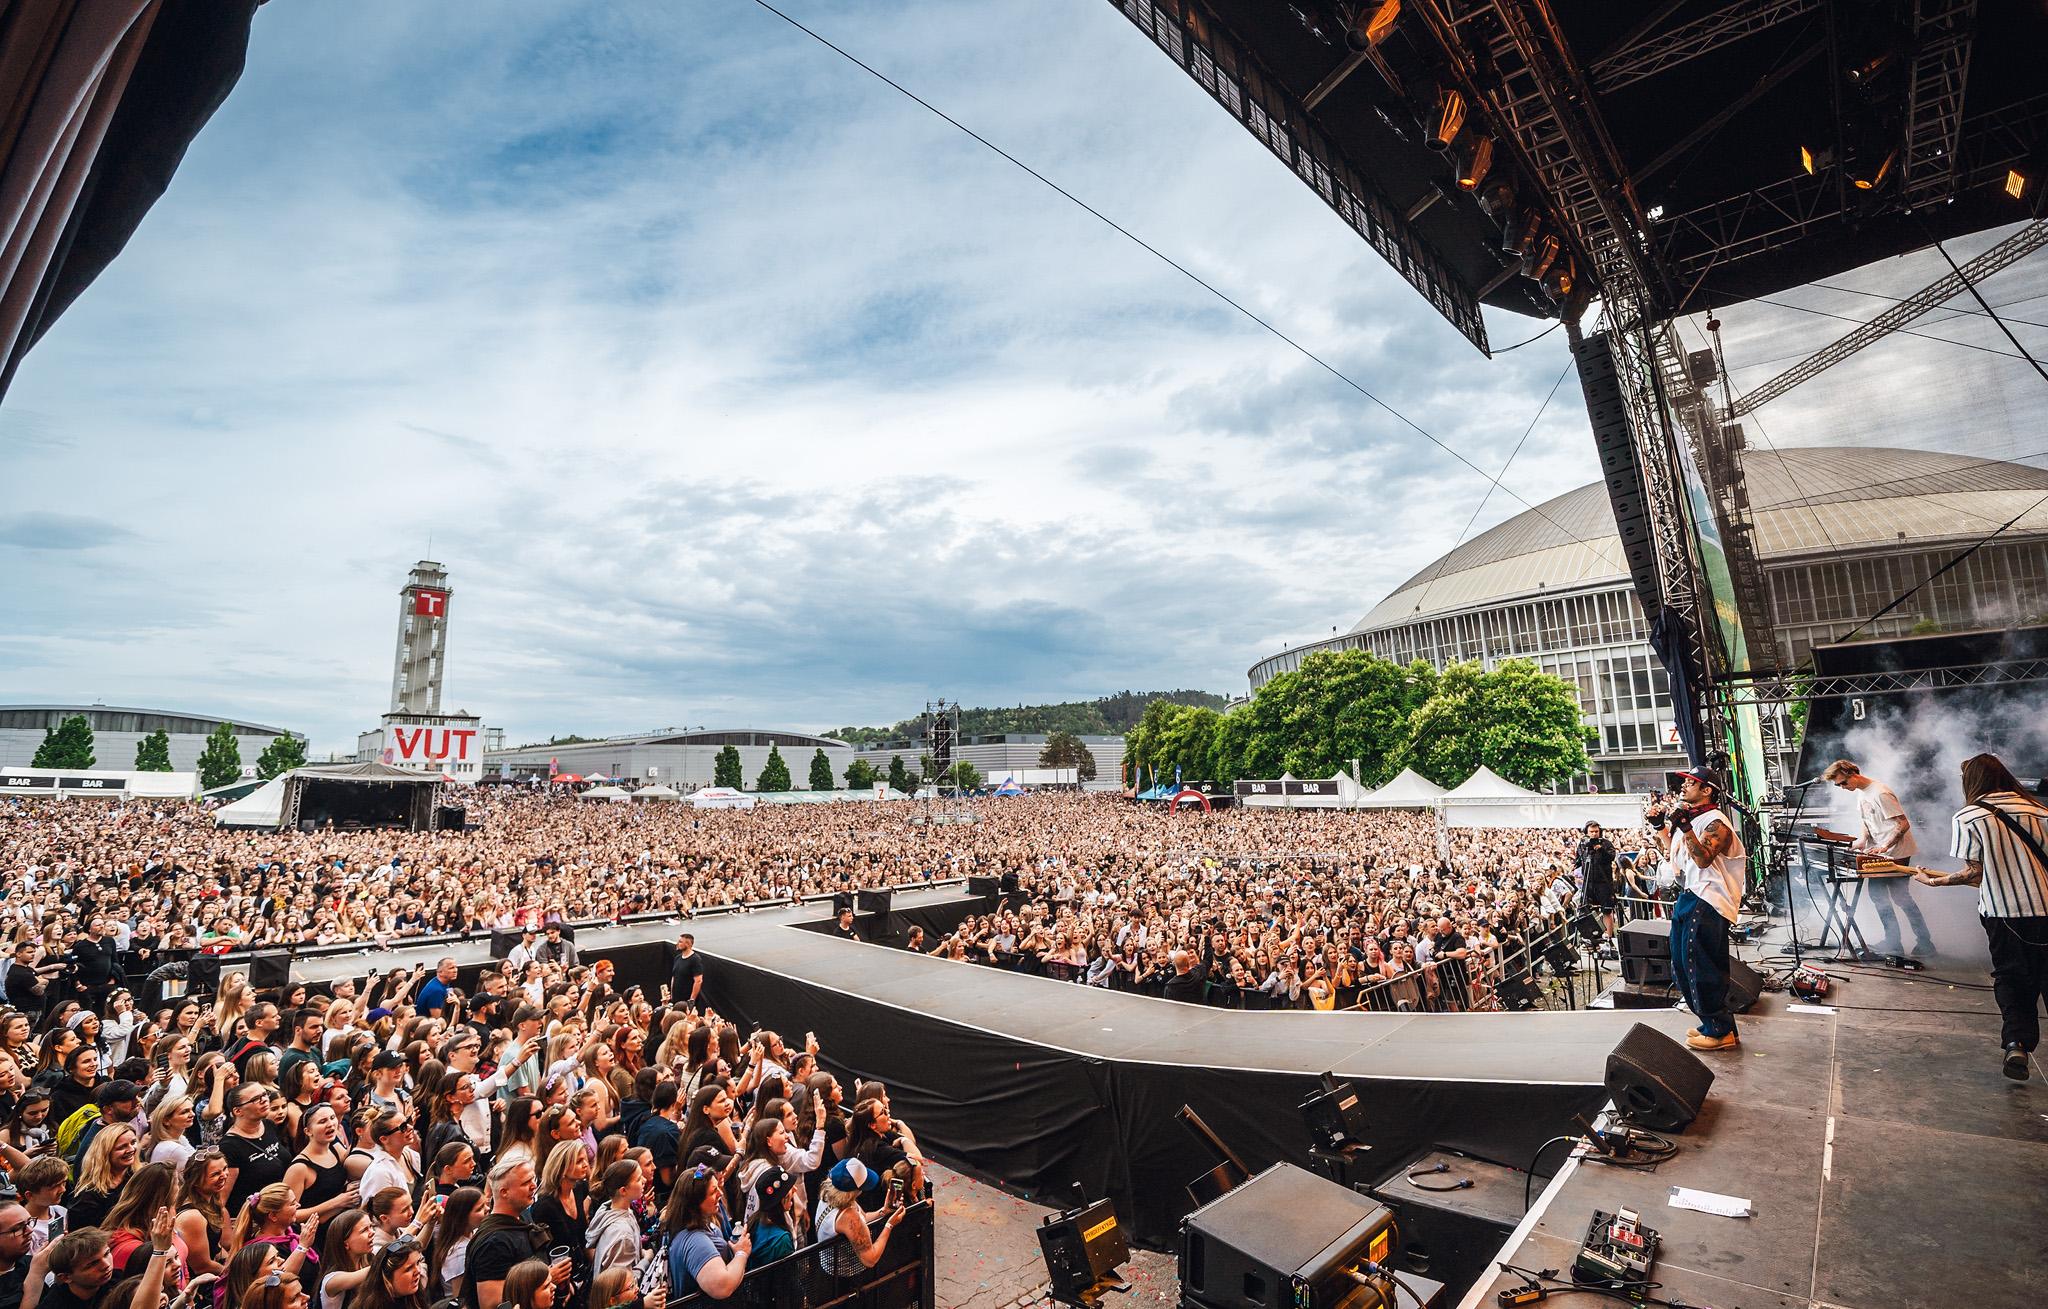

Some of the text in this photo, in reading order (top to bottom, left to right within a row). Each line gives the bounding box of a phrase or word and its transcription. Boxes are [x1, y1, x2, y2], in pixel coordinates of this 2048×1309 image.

[421, 593, 441, 612] T
[1669, 728, 1679, 741] Z
[395, 728, 476, 760] VUT
[8, 778, 31, 786] BAR
[82, 780, 103, 788] BAR
[1201, 784, 1212, 792] glo
[1251, 783, 1267, 793] BAR
[1302, 783, 1320, 793] BAR
[878, 789, 884, 799] Z
